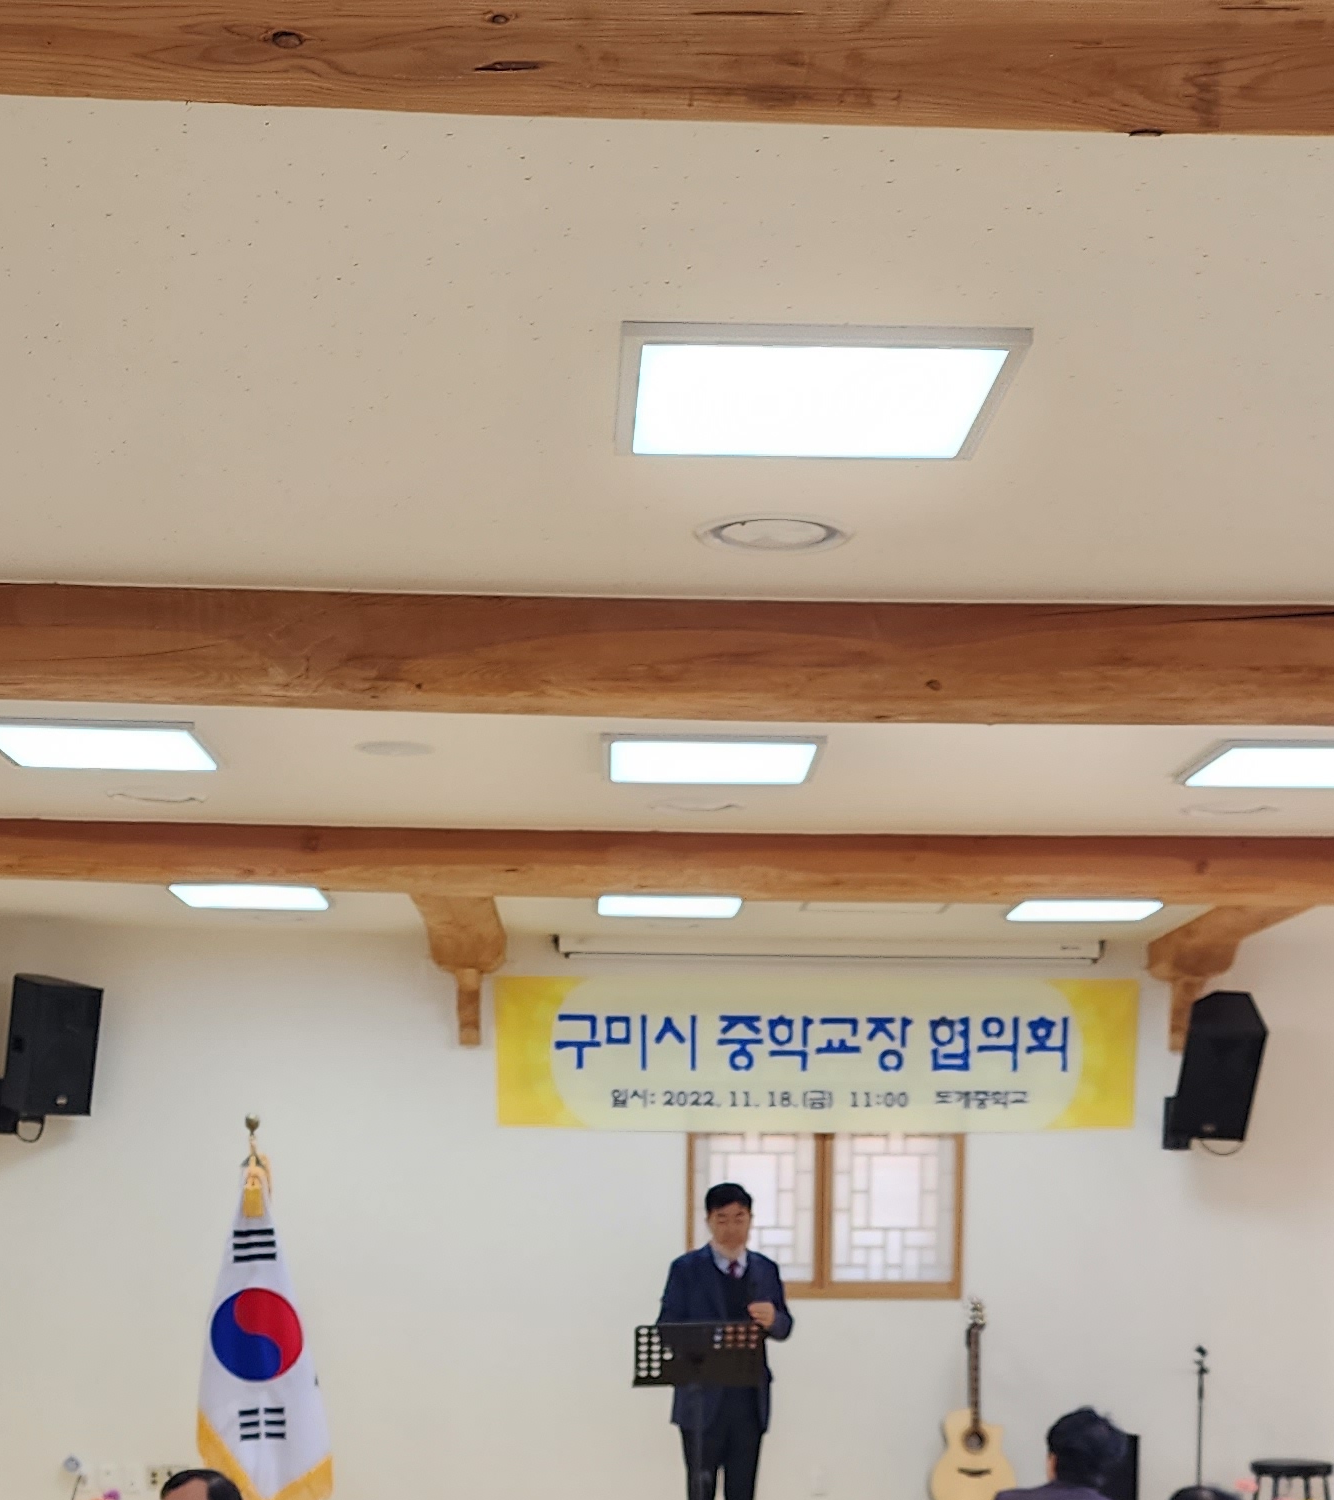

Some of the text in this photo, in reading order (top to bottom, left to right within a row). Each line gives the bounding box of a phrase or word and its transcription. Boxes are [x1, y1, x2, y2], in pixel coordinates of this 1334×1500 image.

[553, 1013, 1071, 1073] 구미시 중학교장 협의회
[610, 1088, 656, 1109] 일시:
[850, 1091, 911, 1109] 11:00
